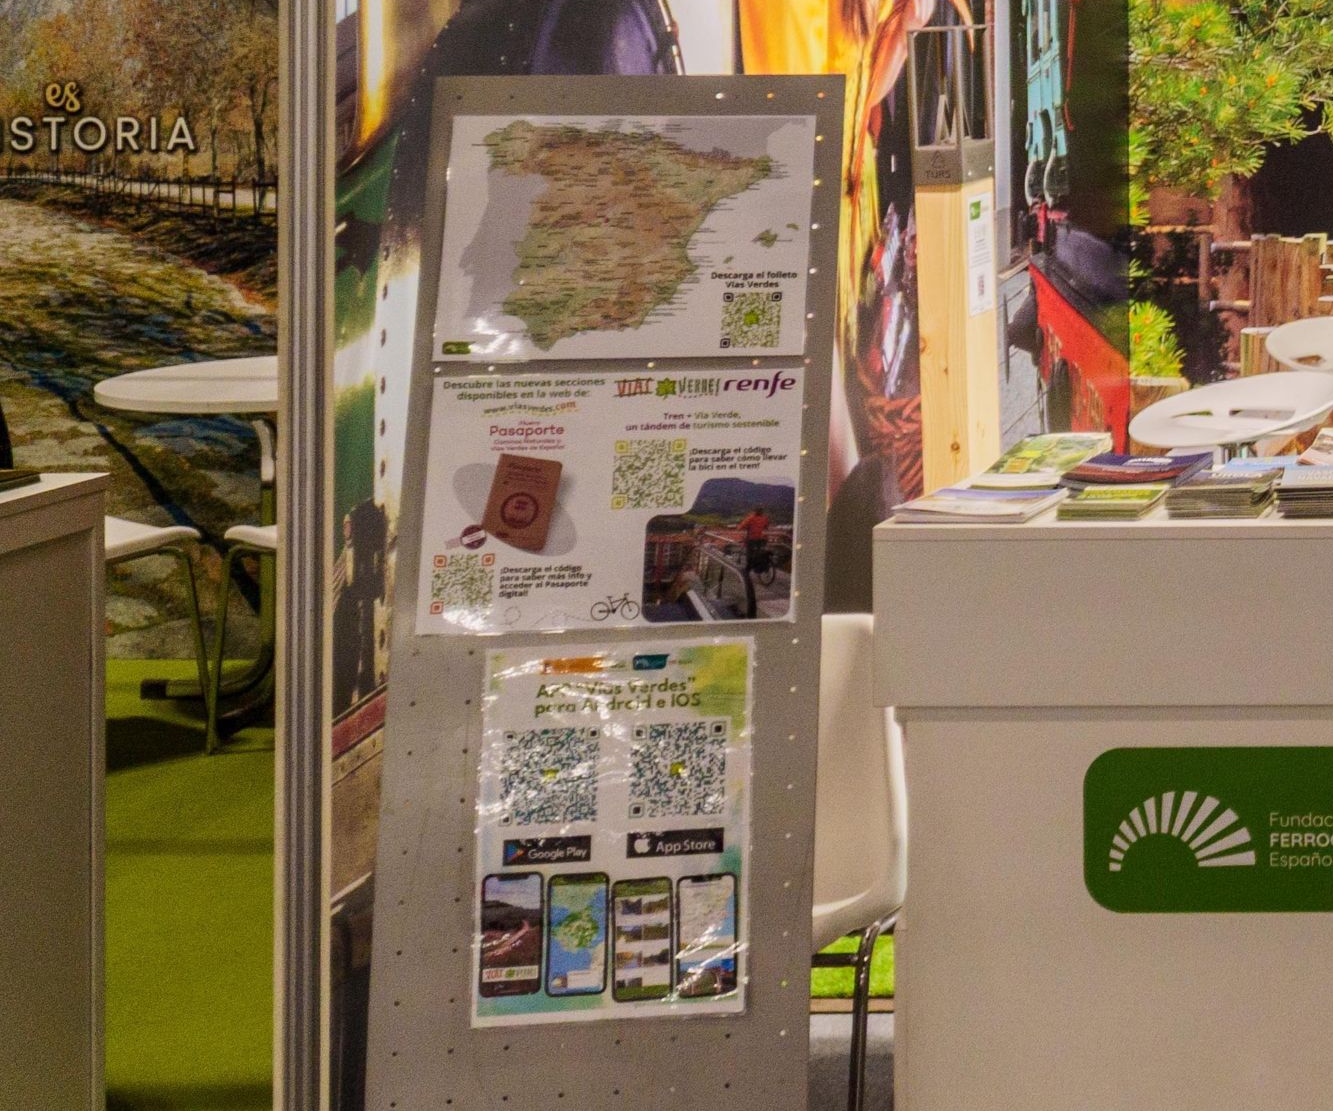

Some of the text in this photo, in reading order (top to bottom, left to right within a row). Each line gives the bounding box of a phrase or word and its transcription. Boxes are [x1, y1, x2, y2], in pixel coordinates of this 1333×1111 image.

[45, 81, 81, 113] es
[711, 271, 798, 281] Descarga el folleto
[748, 281, 780, 289] Verdes
[443, 378, 606, 390] Descubre las nuevas secciones
[614, 377, 654, 398] VIAS
[723, 371, 797, 399] renfe
[456, 390, 518, 402] disponibles
[520, 391, 535, 399] en
[537, 390, 547, 398] la
[550, 389, 571, 398] web
[664, 412, 685, 420] Tren
[679, 421, 691, 430] de
[692, 421, 731, 429] turismo
[732, 419, 780, 429] sostenible
[489, 424, 565, 439] Pasaporte
[527, 845, 588, 859] Google Play
[655, 839, 716, 855] App Store
